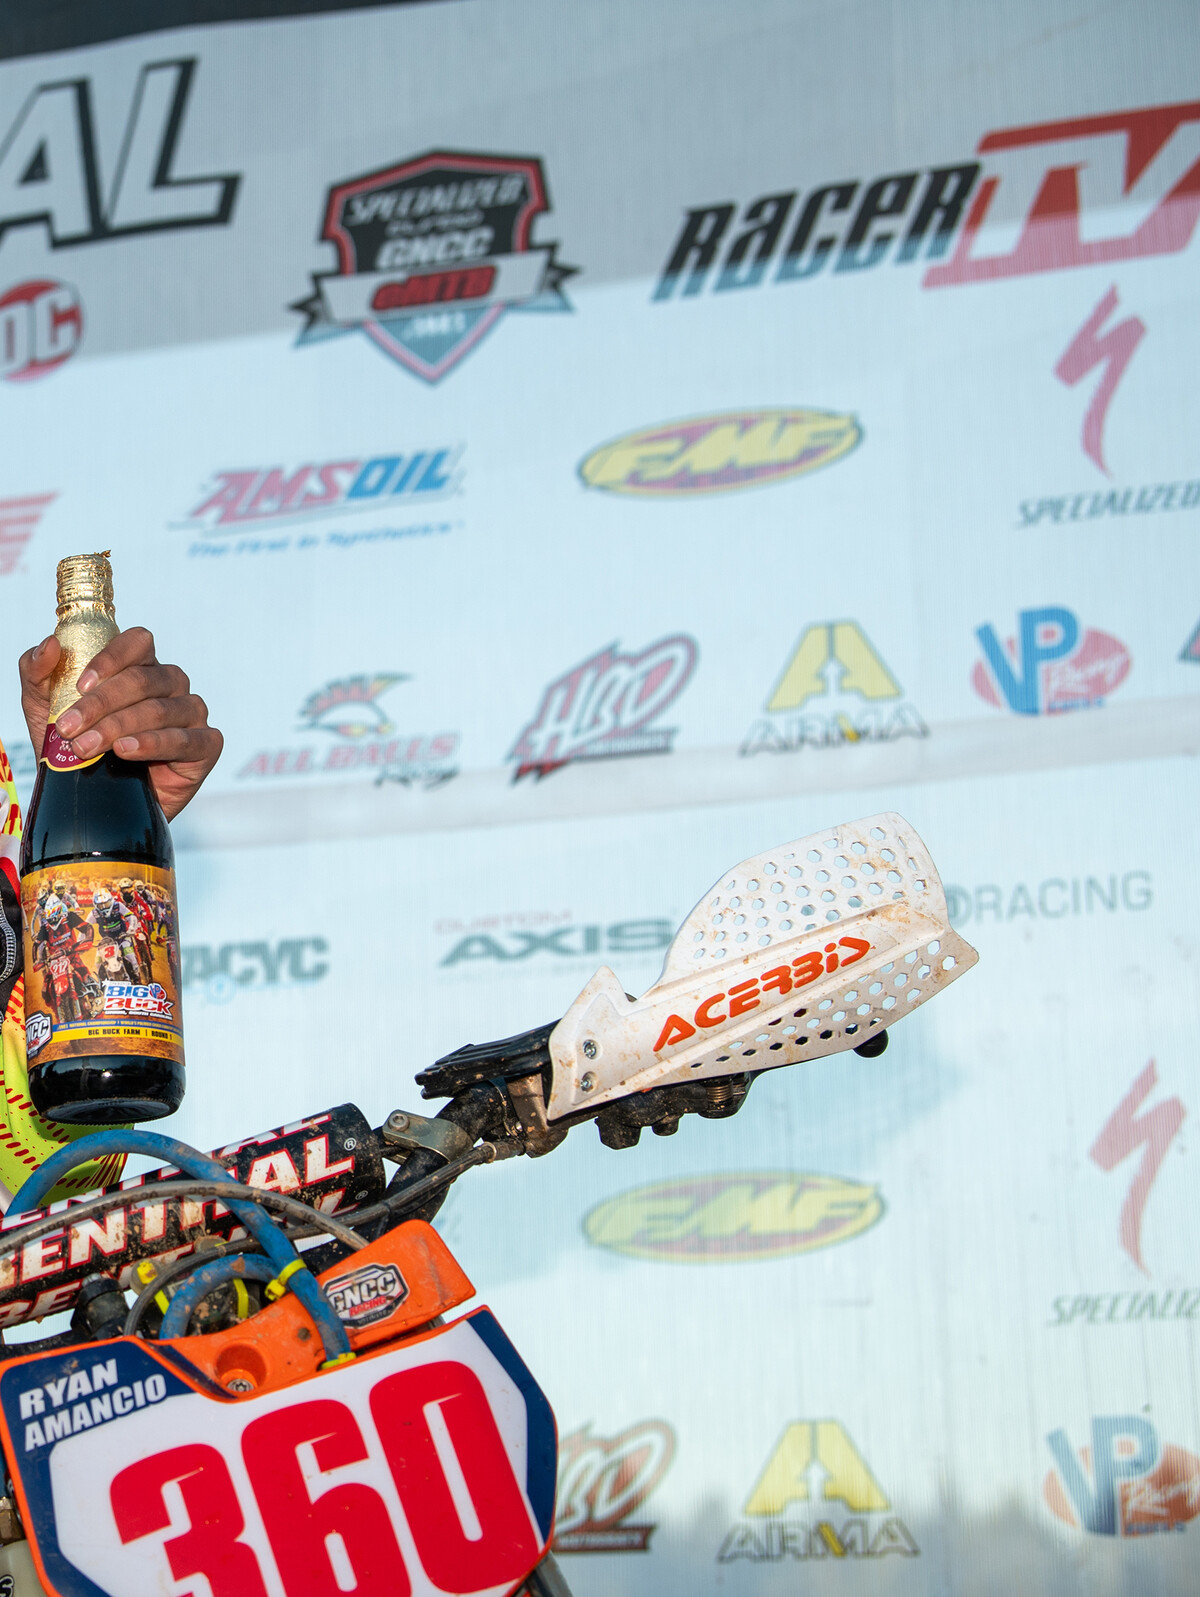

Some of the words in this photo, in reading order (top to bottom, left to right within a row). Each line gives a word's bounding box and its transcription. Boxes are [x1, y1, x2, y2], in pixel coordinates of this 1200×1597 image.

[582, 411, 863, 491] FMF
[188, 447, 452, 526] AMSOIL
[974, 604, 1081, 717] VP
[104, 945, 115, 959] 3
[181, 934, 331, 990] ACYC
[437, 917, 674, 969] AXIS
[105, 984, 149, 998] BIG
[105, 997, 173, 1014] BUCK
[652, 935, 873, 1053] ACERBIS
[88, 1028, 100, 1036] BIG
[123, 1028, 141, 1036] FARM
[151, 1030, 169, 1039] ROUND
[583, 1180, 885, 1246] FMF
[327, 1271, 397, 1312] GNCC
[349, 1295, 388, 1318] RACING
[19, 1357, 119, 1421] RYAN
[23, 1372, 168, 1453] AMANCIO
[109, 1359, 541, 1597] 360
[1045, 1412, 1160, 1537] VP
[714, 1516, 923, 1565] ARMA
